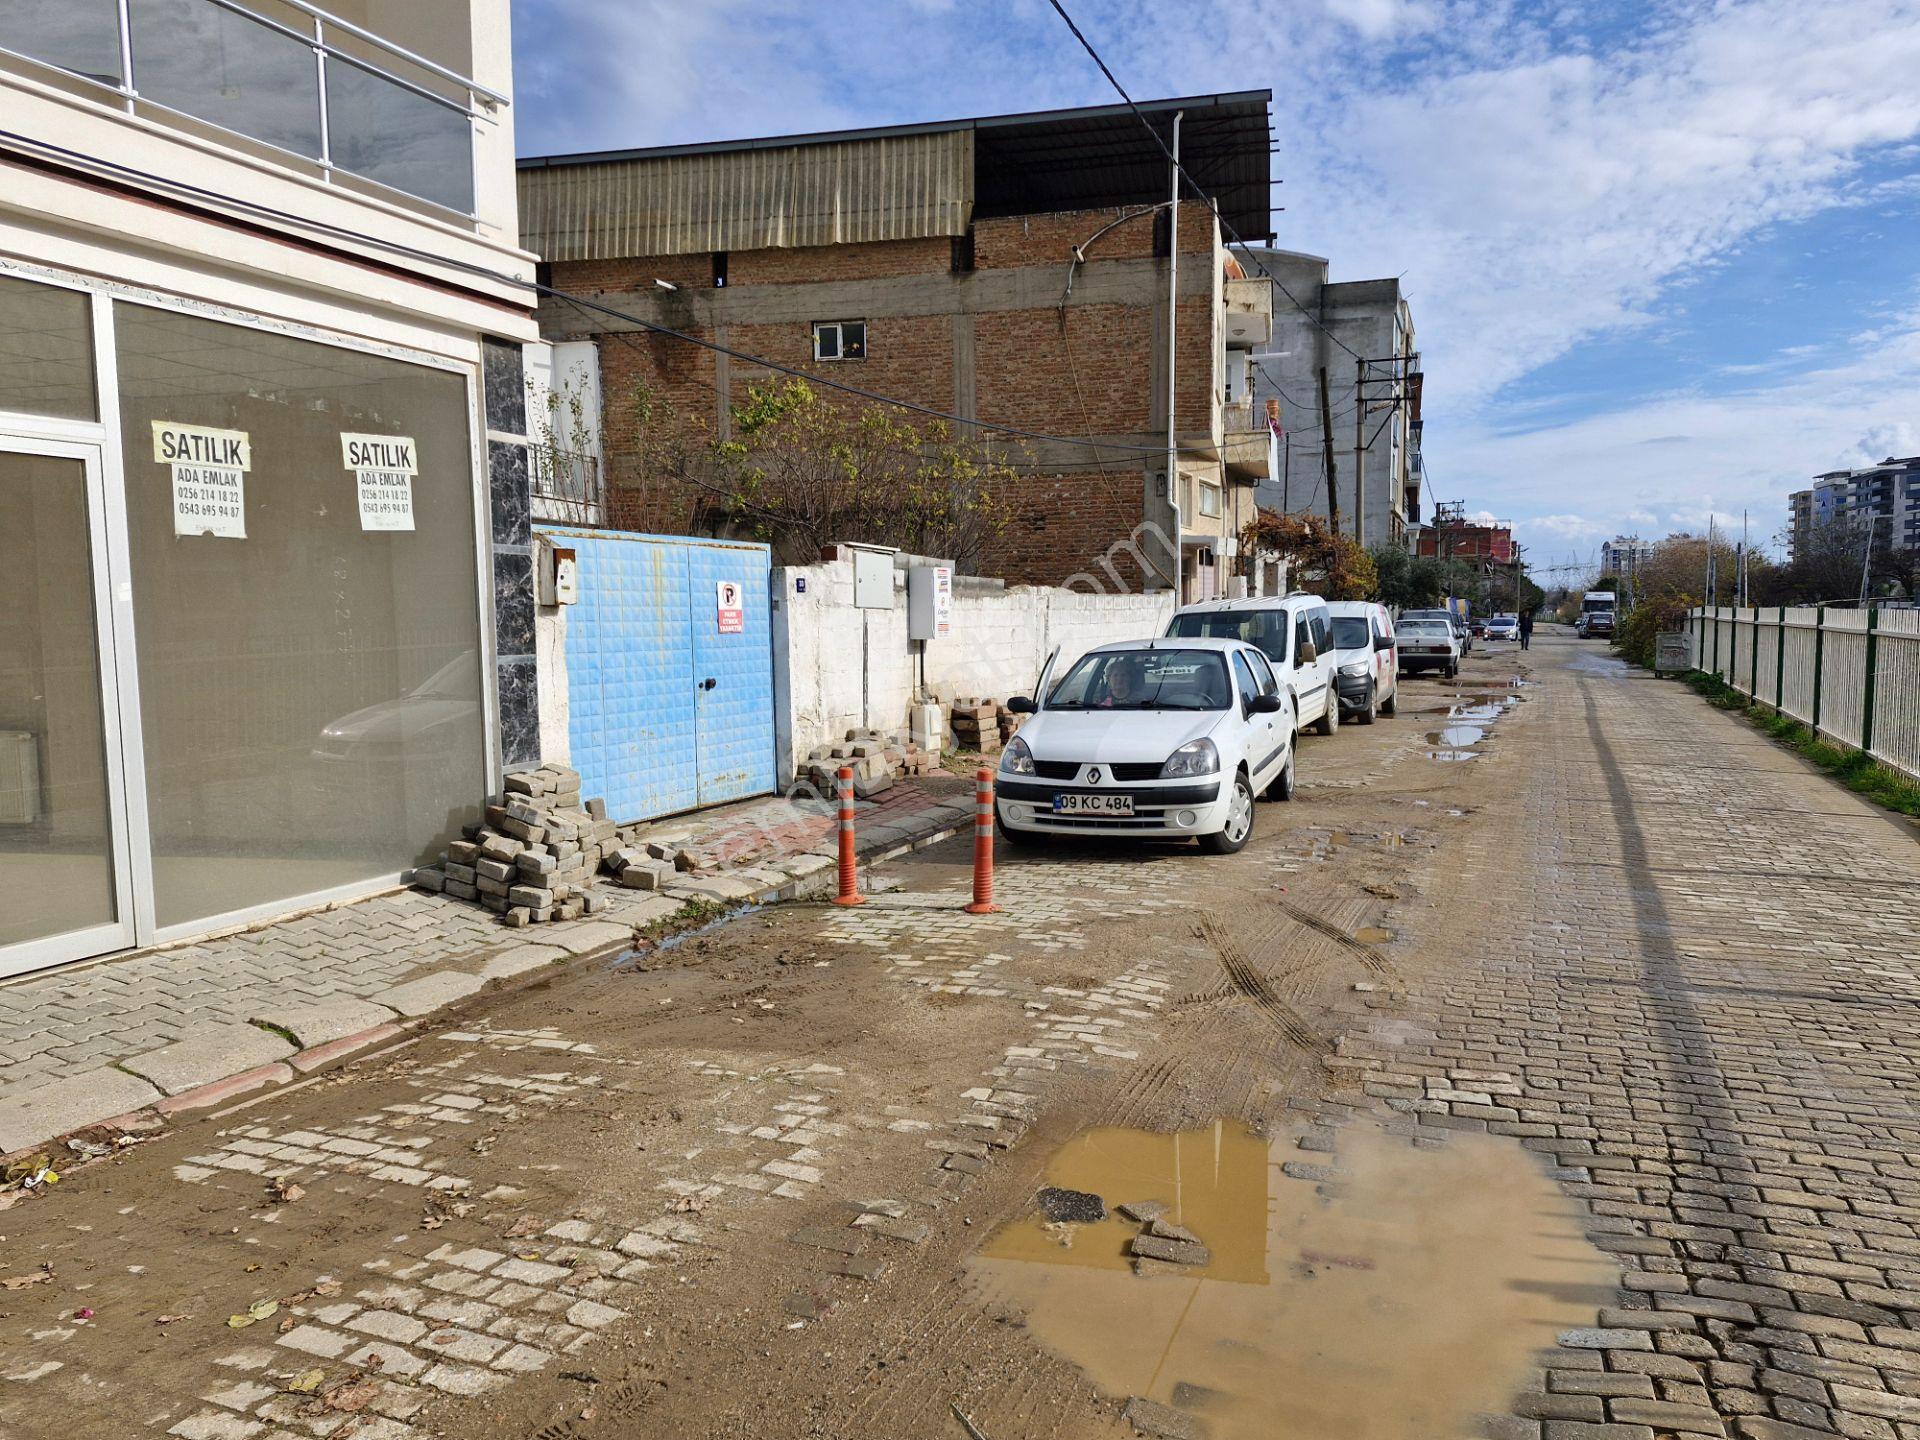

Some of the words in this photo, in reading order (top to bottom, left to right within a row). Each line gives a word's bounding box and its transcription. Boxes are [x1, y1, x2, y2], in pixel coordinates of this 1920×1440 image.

[161, 430, 243, 466] SATILIK
[349, 441, 411, 468] SATILIK
[177, 467, 199, 484] ADA
[203, 469, 238, 487] EMLAK
[360, 472, 377, 485] ADA
[379, 472, 407, 487] EMLAK
[178, 486, 198, 500] 0256
[201, 489, 215, 501] 214
[218, 490, 228, 502] 18
[229, 491, 239, 503] 22
[179, 502, 200, 516] 0543
[201, 504, 216, 517] 695
[218, 506, 229, 517] 94
[230, 506, 240, 518] 87
[1061, 796, 1077, 809] 09
[1081, 796, 1101, 809] KC
[1105, 797, 1131, 810] 484
